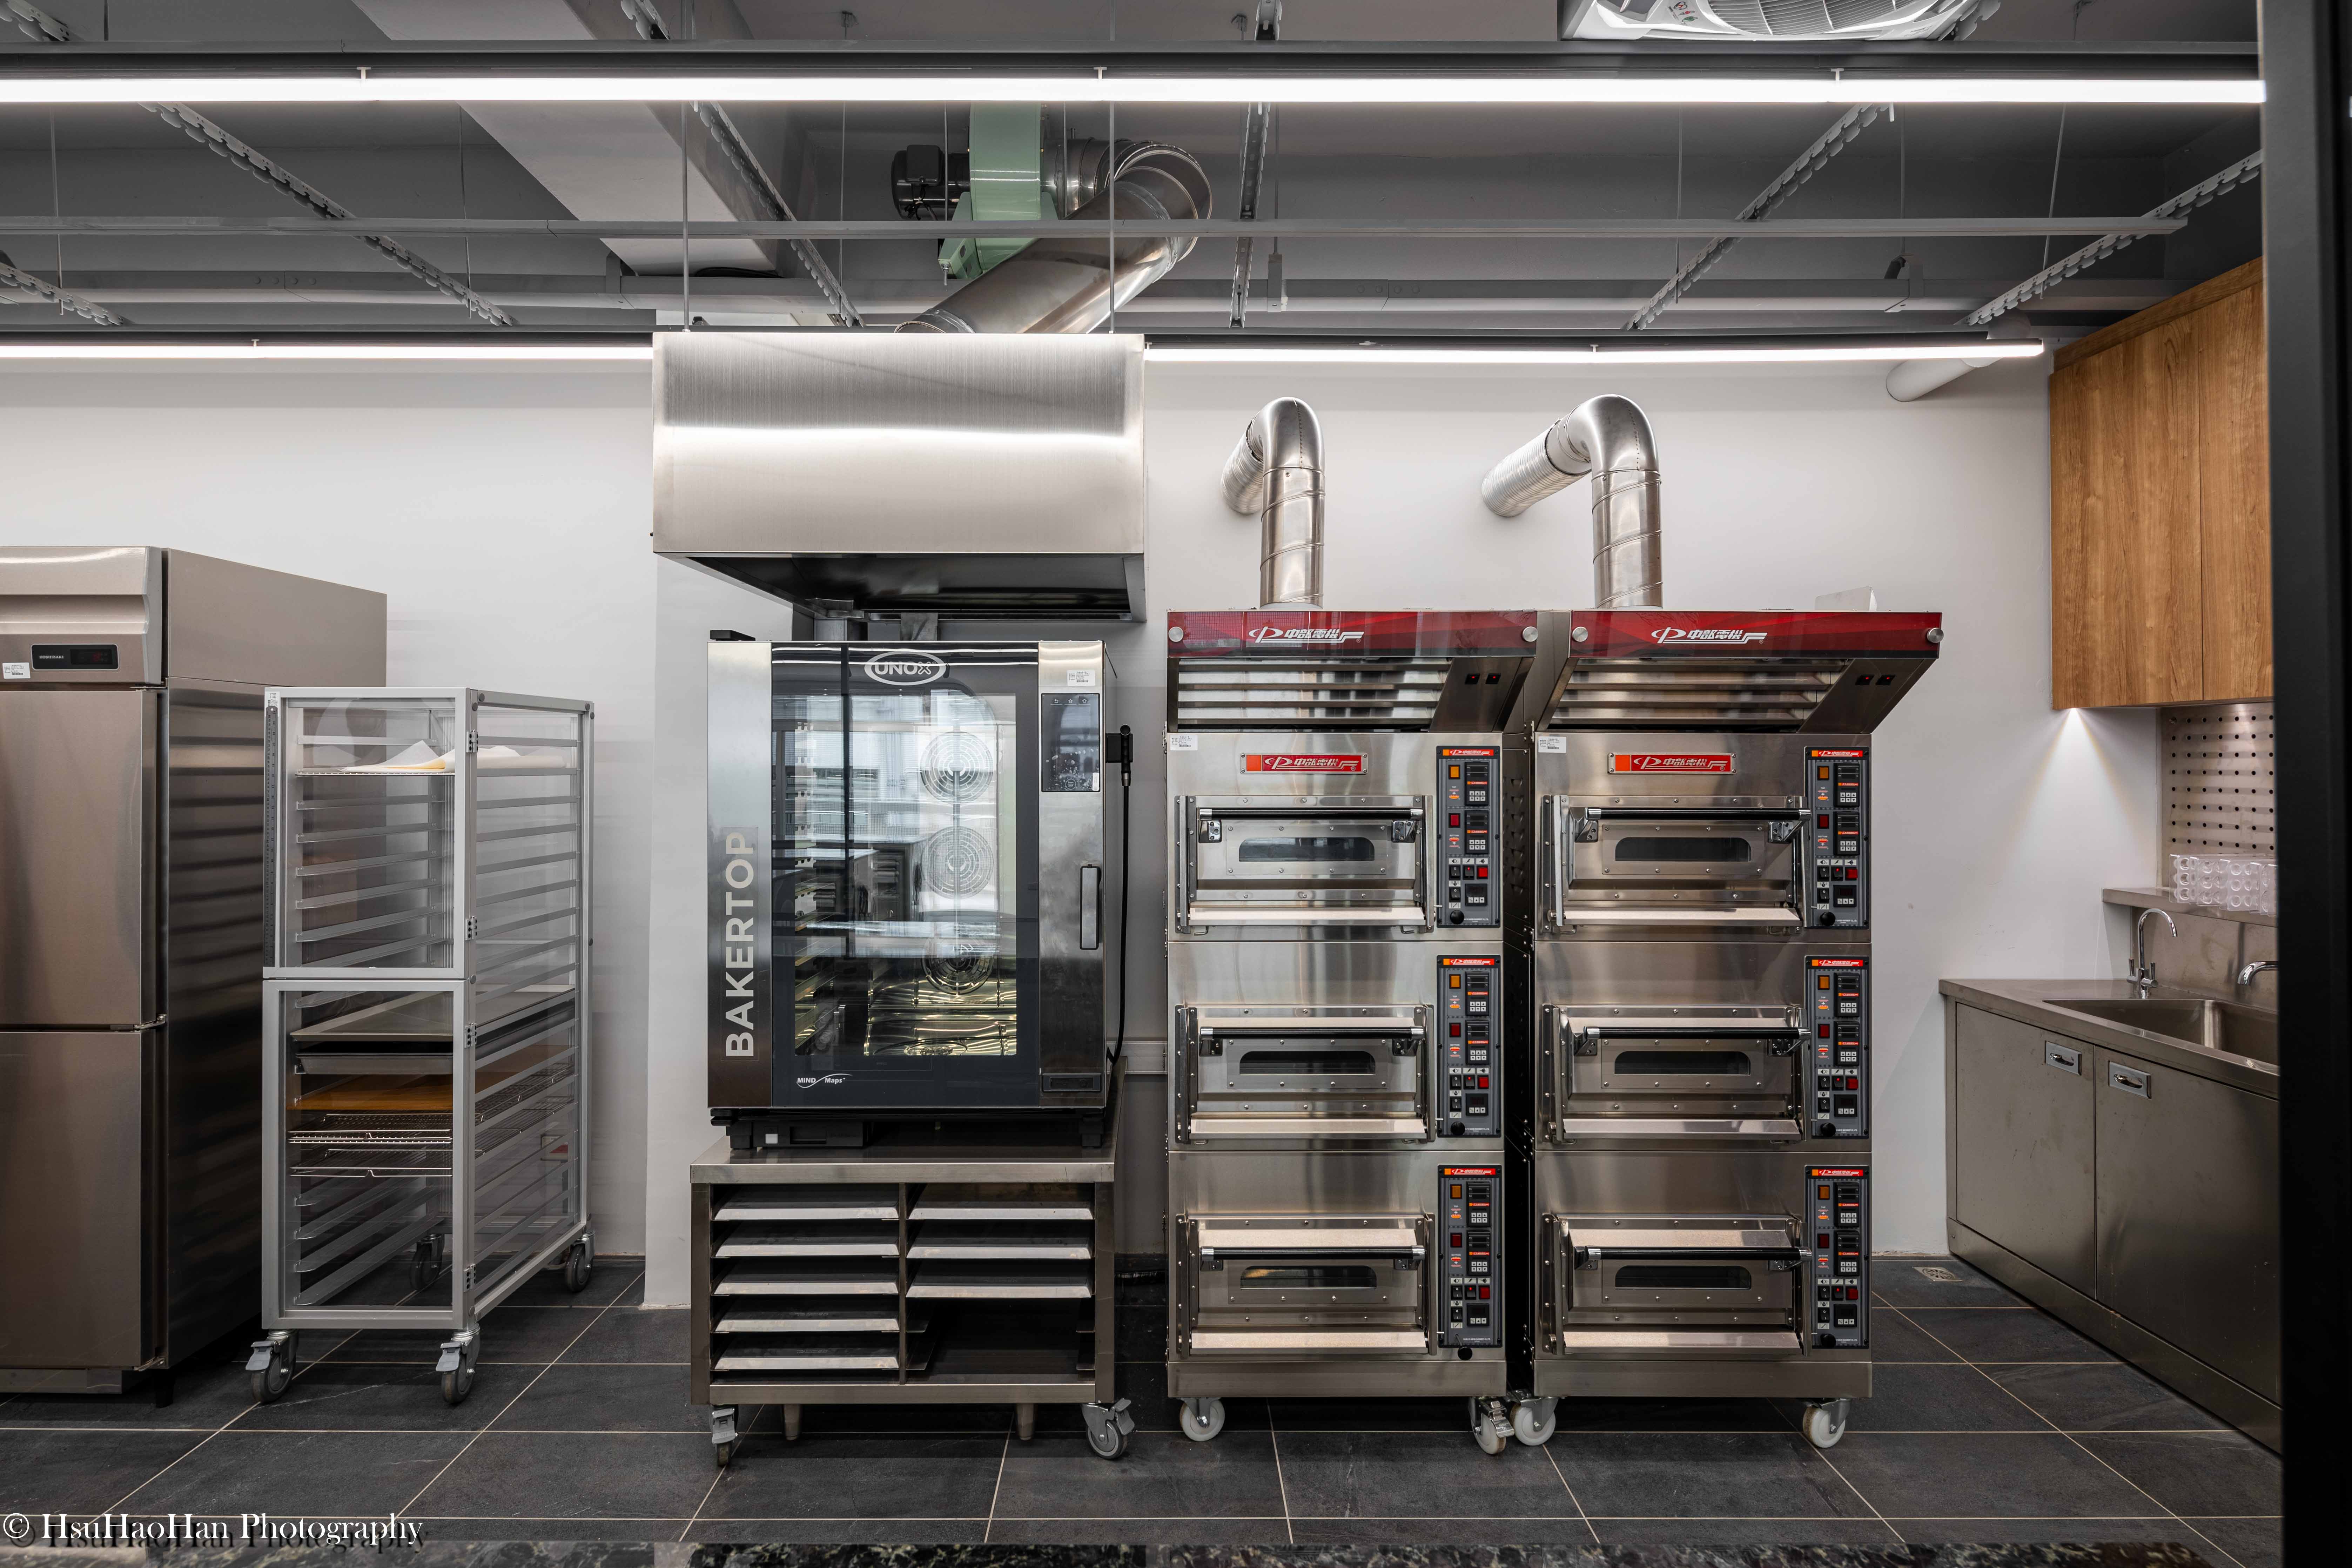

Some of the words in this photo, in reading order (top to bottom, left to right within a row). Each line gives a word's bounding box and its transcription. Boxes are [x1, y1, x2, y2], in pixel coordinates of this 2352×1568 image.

[1284, 629, 1340, 639] 中部電機
[1687, 630, 1743, 639] 中部電機
[875, 661, 932, 675] UNOX
[725, 832, 754, 1056] BAKERTOP
